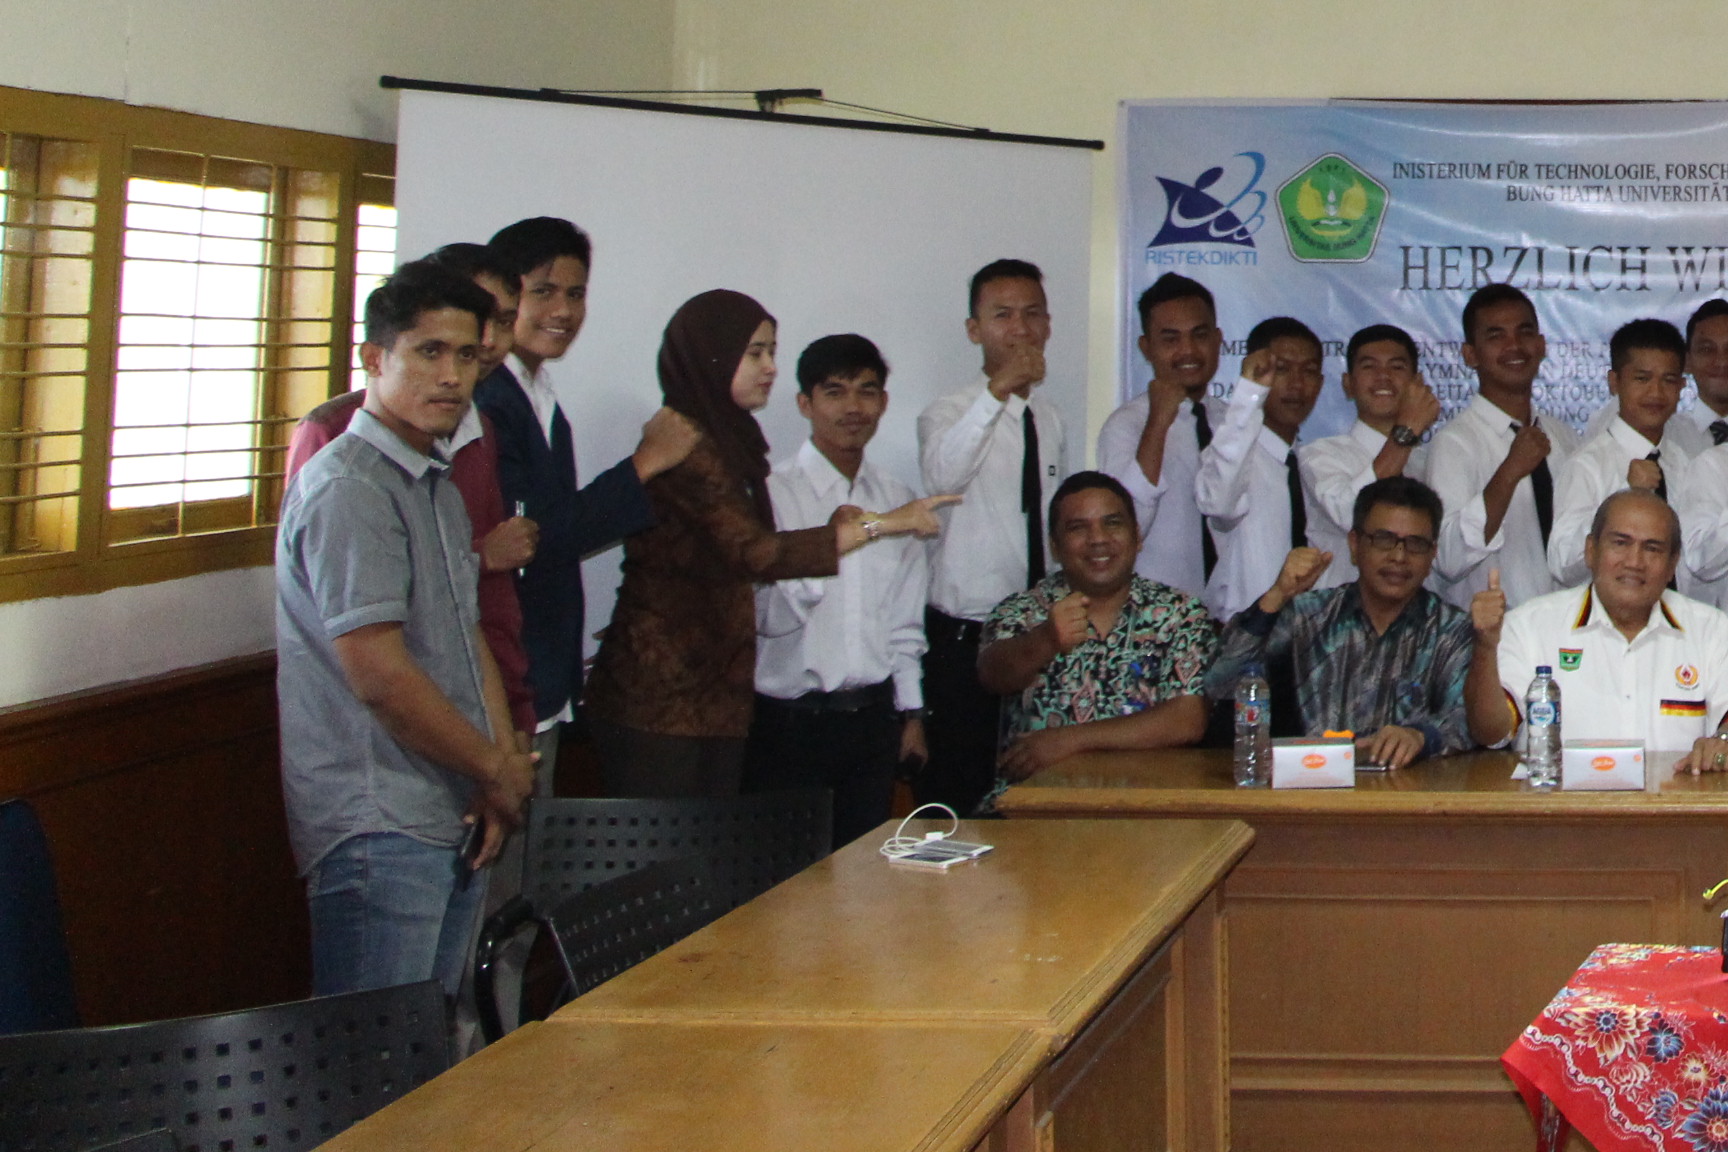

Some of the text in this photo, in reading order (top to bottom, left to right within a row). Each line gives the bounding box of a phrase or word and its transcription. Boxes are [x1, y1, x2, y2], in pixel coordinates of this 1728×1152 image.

[1497, 159, 1528, 180] FÜR
[1535, 163, 1660, 182] TECHNOLOGIE,
[1506, 185, 1555, 202] BUNG
[1560, 185, 1615, 202] HATTA
[1145, 251, 1258, 266] RISTEKDIKTI
[1400, 245, 1652, 291] HERZLICH
